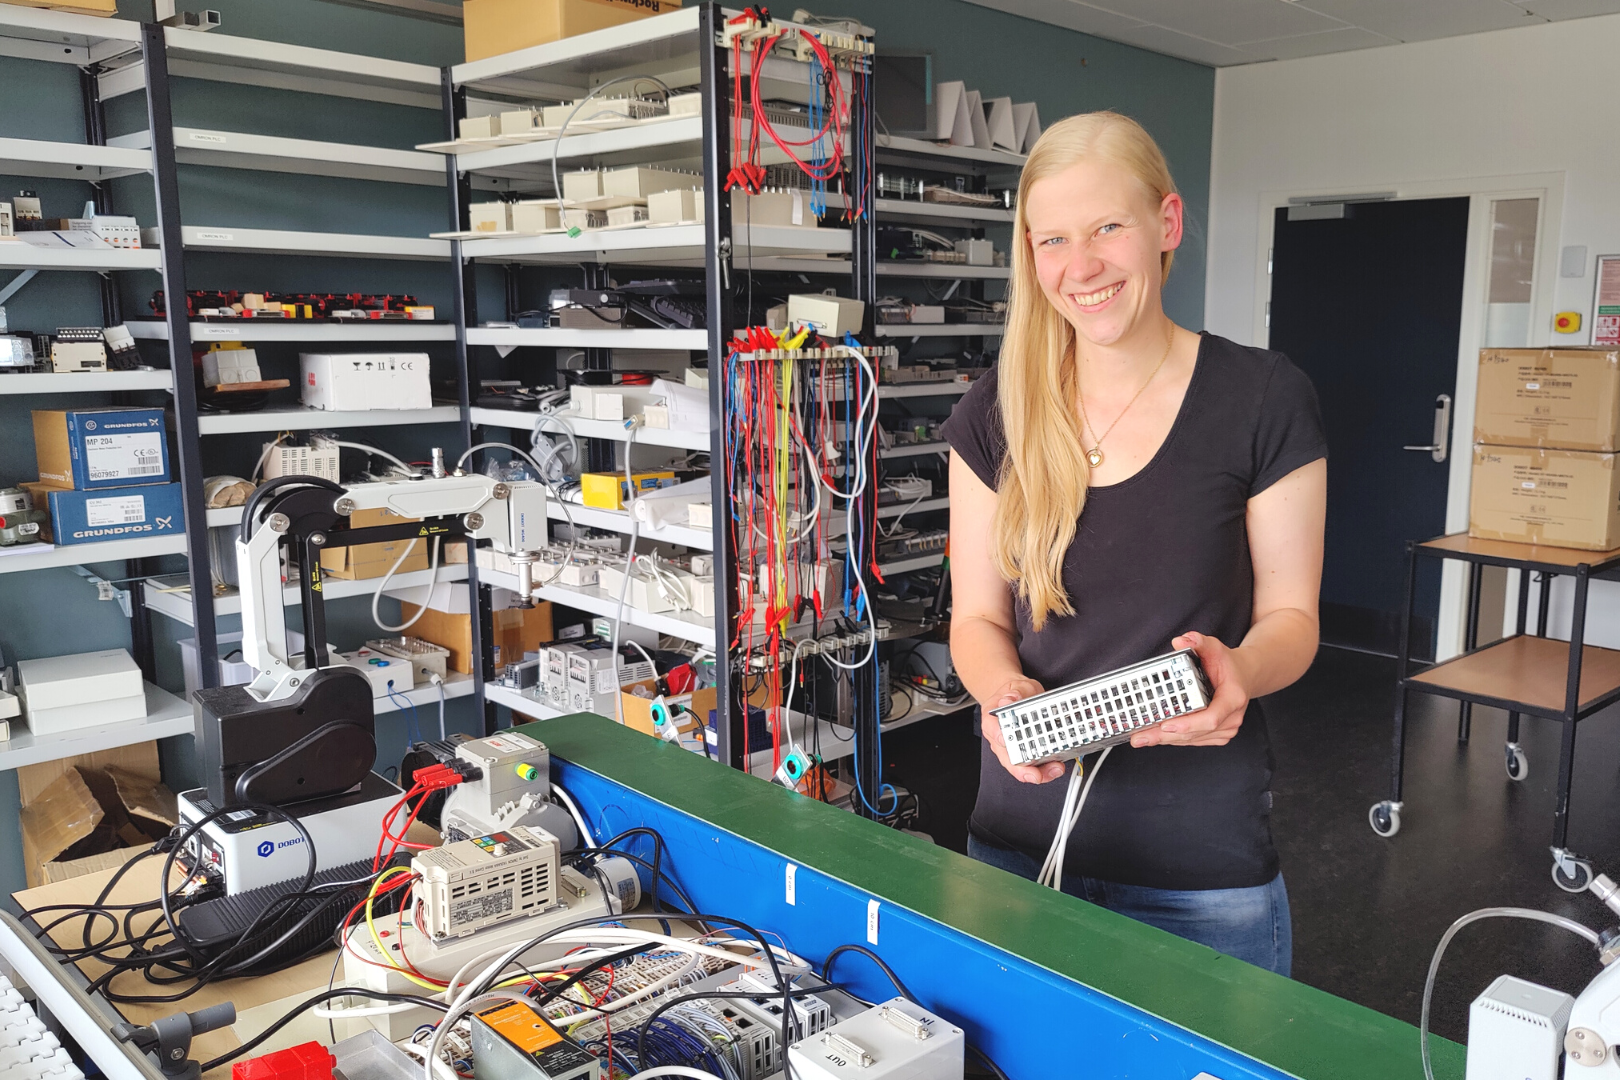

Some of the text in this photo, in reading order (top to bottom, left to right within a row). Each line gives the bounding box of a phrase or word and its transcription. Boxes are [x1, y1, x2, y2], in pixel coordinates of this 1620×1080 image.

[606, 0, 660, 12] Rock
[86, 437, 113, 446] MP 204
[40, 472, 65, 482] GRUNDFOS
[90, 470, 119, 479] 96079927
[73, 525, 152, 538] GRUNDFOS
[277, 836, 305, 849] DOBOT
[919, 1017, 935, 1026] IN
[825, 1054, 847, 1067] OUT
